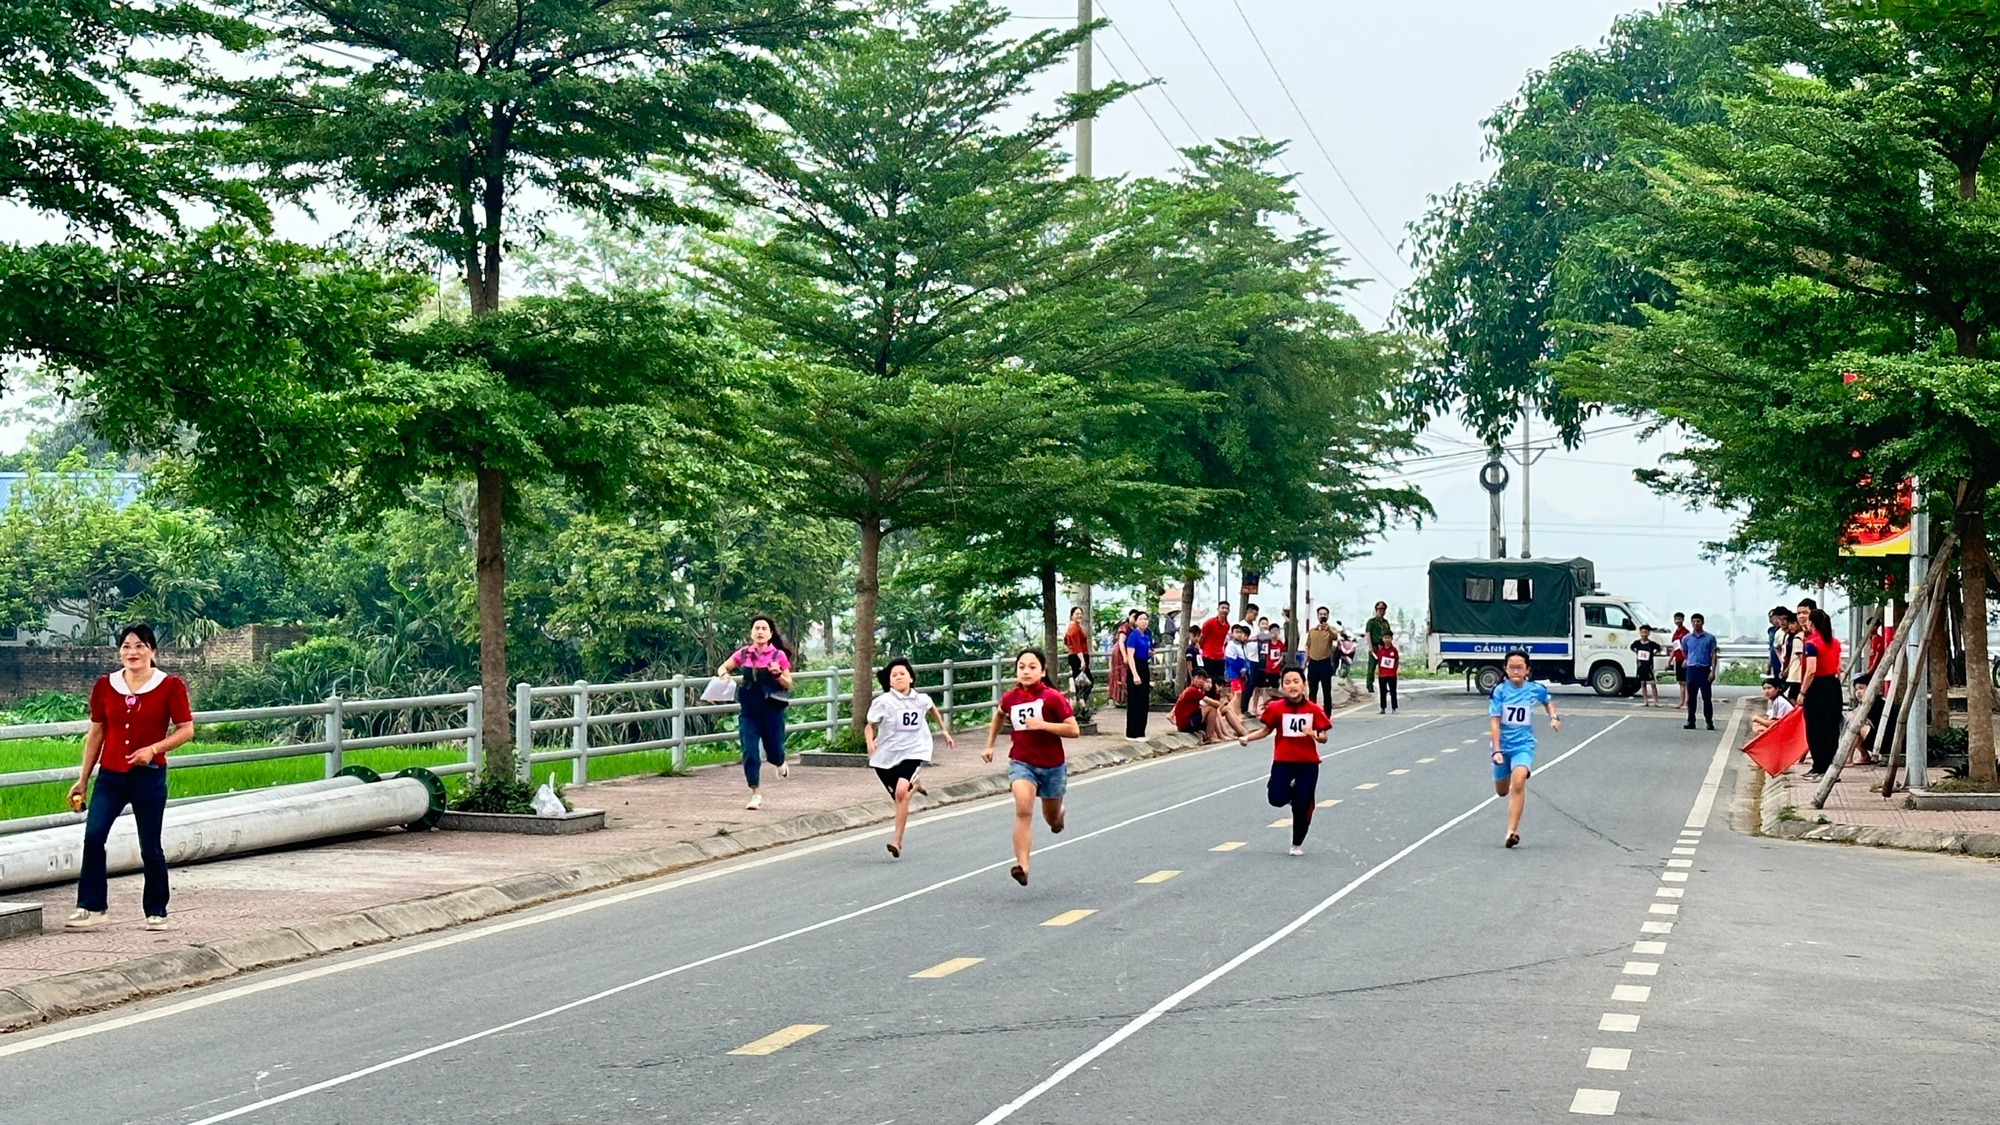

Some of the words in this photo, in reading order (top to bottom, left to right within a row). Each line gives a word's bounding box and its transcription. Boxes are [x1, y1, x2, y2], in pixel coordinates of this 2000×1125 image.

[1474, 642, 1506, 653] CẢNH
[903, 712, 918, 726] 62
[1507, 707, 1525, 722] 70
